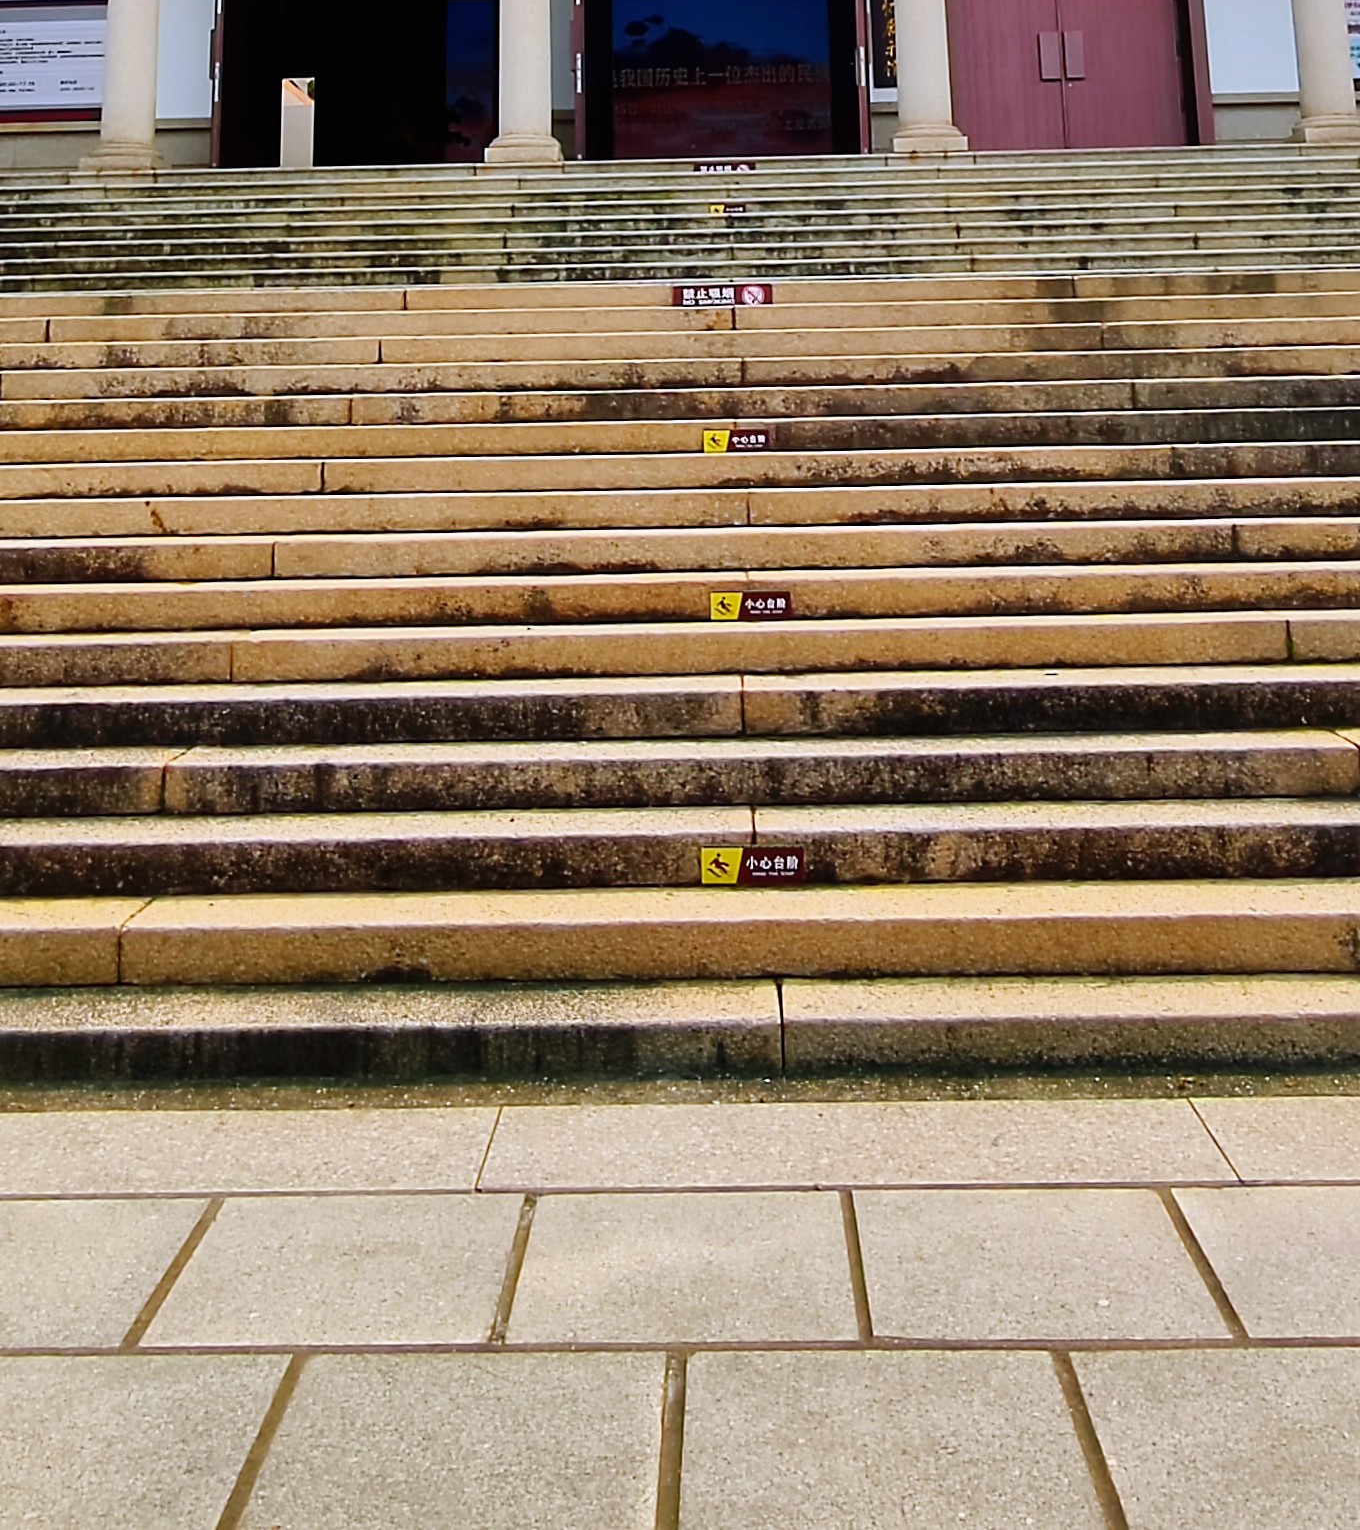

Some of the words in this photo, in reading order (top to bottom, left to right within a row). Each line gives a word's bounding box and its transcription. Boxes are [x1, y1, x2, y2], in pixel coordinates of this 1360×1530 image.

[744, 597, 786, 609] 小心台阶
[745, 855, 799, 870] 小心台阶
